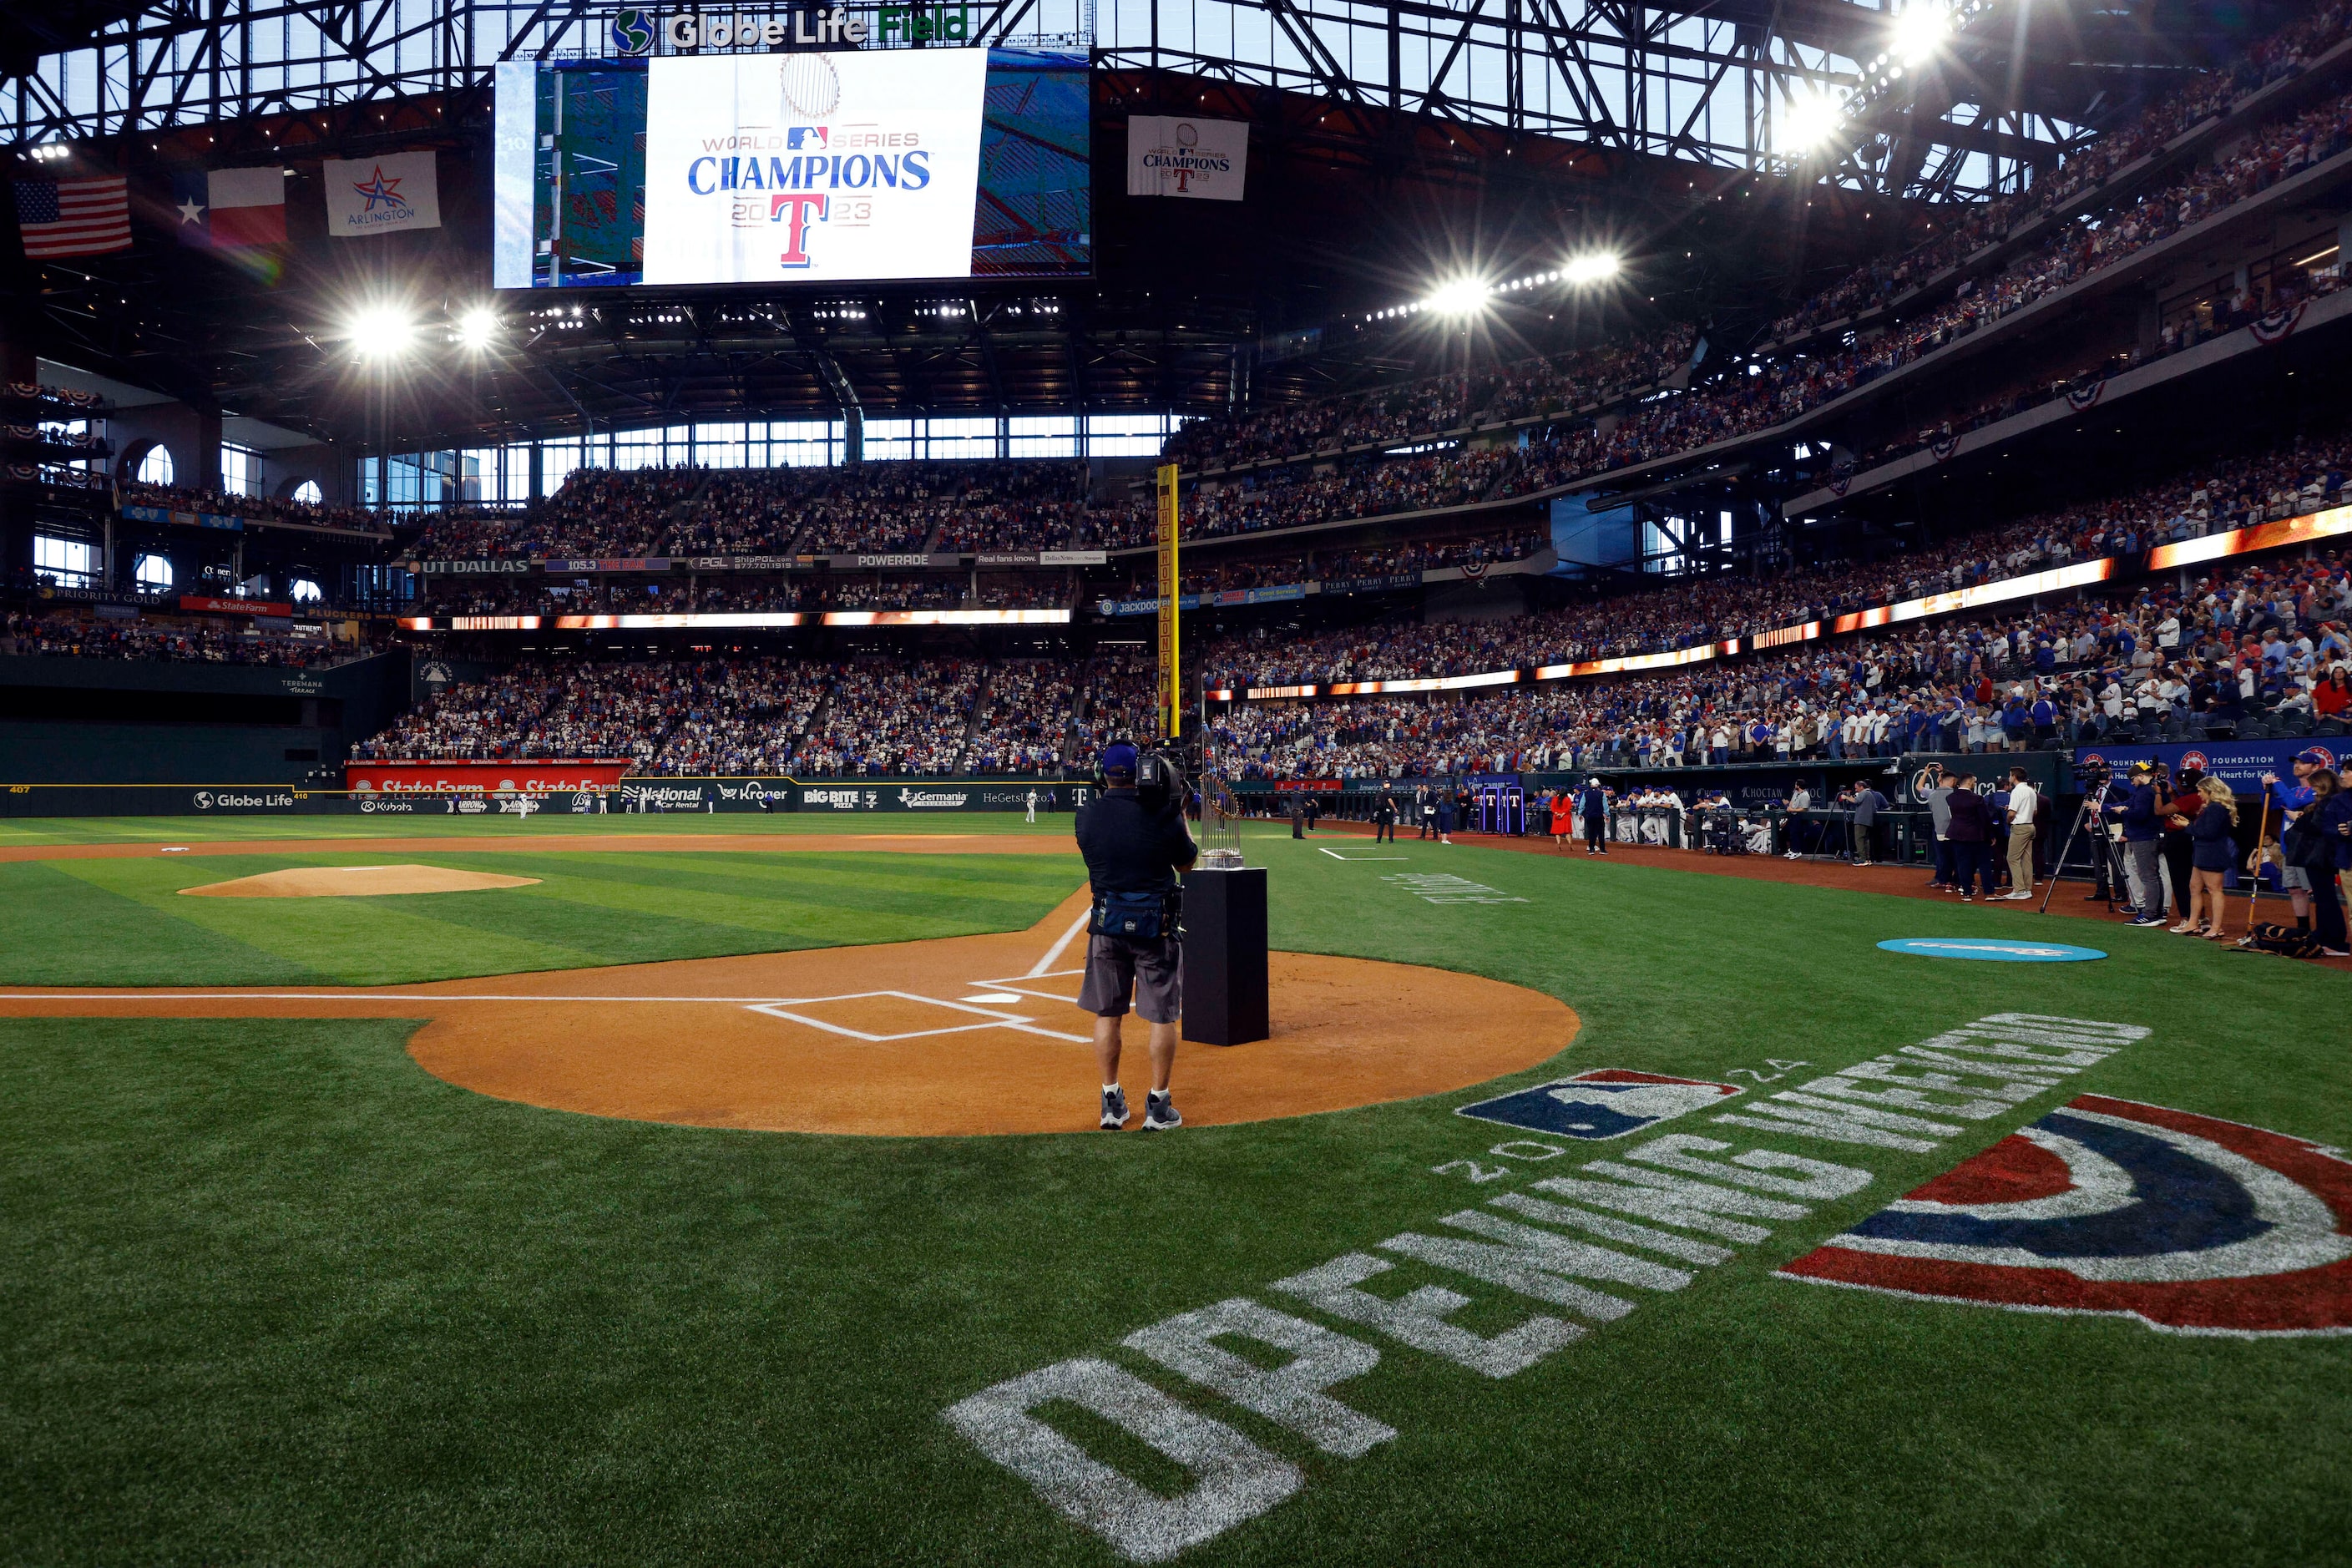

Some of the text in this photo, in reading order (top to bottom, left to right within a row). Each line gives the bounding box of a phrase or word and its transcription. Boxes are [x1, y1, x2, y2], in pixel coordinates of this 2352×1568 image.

[667, 4, 969, 48] Globe Life Field
[701, 133, 919, 152] WORLD SERIES
[1143, 154, 1230, 171] CHAMPIONS
[688, 150, 930, 195] CHAMPIONS
[348, 209, 414, 225] ARLINGTON
[731, 202, 872, 220] 20 23
[771, 194, 829, 268] T
[568, 560, 646, 570] 105.3 THE FAN
[699, 557, 729, 568] PGL
[857, 554, 929, 566] POWERADE
[422, 559, 529, 574] UT DALLAS
[1325, 580, 1351, 589] PERRY
[1357, 577, 1383, 586] PERRY
[1389, 574, 1416, 584] PERRY
[56, 589, 161, 604] PRIORITY GOLD
[308, 607, 372, 621] PLUCKERS
[281, 680, 323, 688] TEREMANA
[2213, 756, 2274, 765] FOUNDATION
[2218, 770, 2243, 779] Heart
[2243, 769, 2252, 778] for
[9, 786, 31, 794] 407
[1746, 787, 1783, 798] CHOCTAW
[217, 793, 293, 807] Globe Life
[829, 791, 860, 803] BITE
[917, 792, 967, 801] Germania
[1486, 794, 1496, 807] T
[1510, 795, 1520, 807] T
[377, 802, 413, 812] Kubota
[1726, 1056, 1817, 1083] 24
[1432, 1141, 1567, 1184] 20
[941, 1012, 2152, 1565] OPENING WEEKEND
